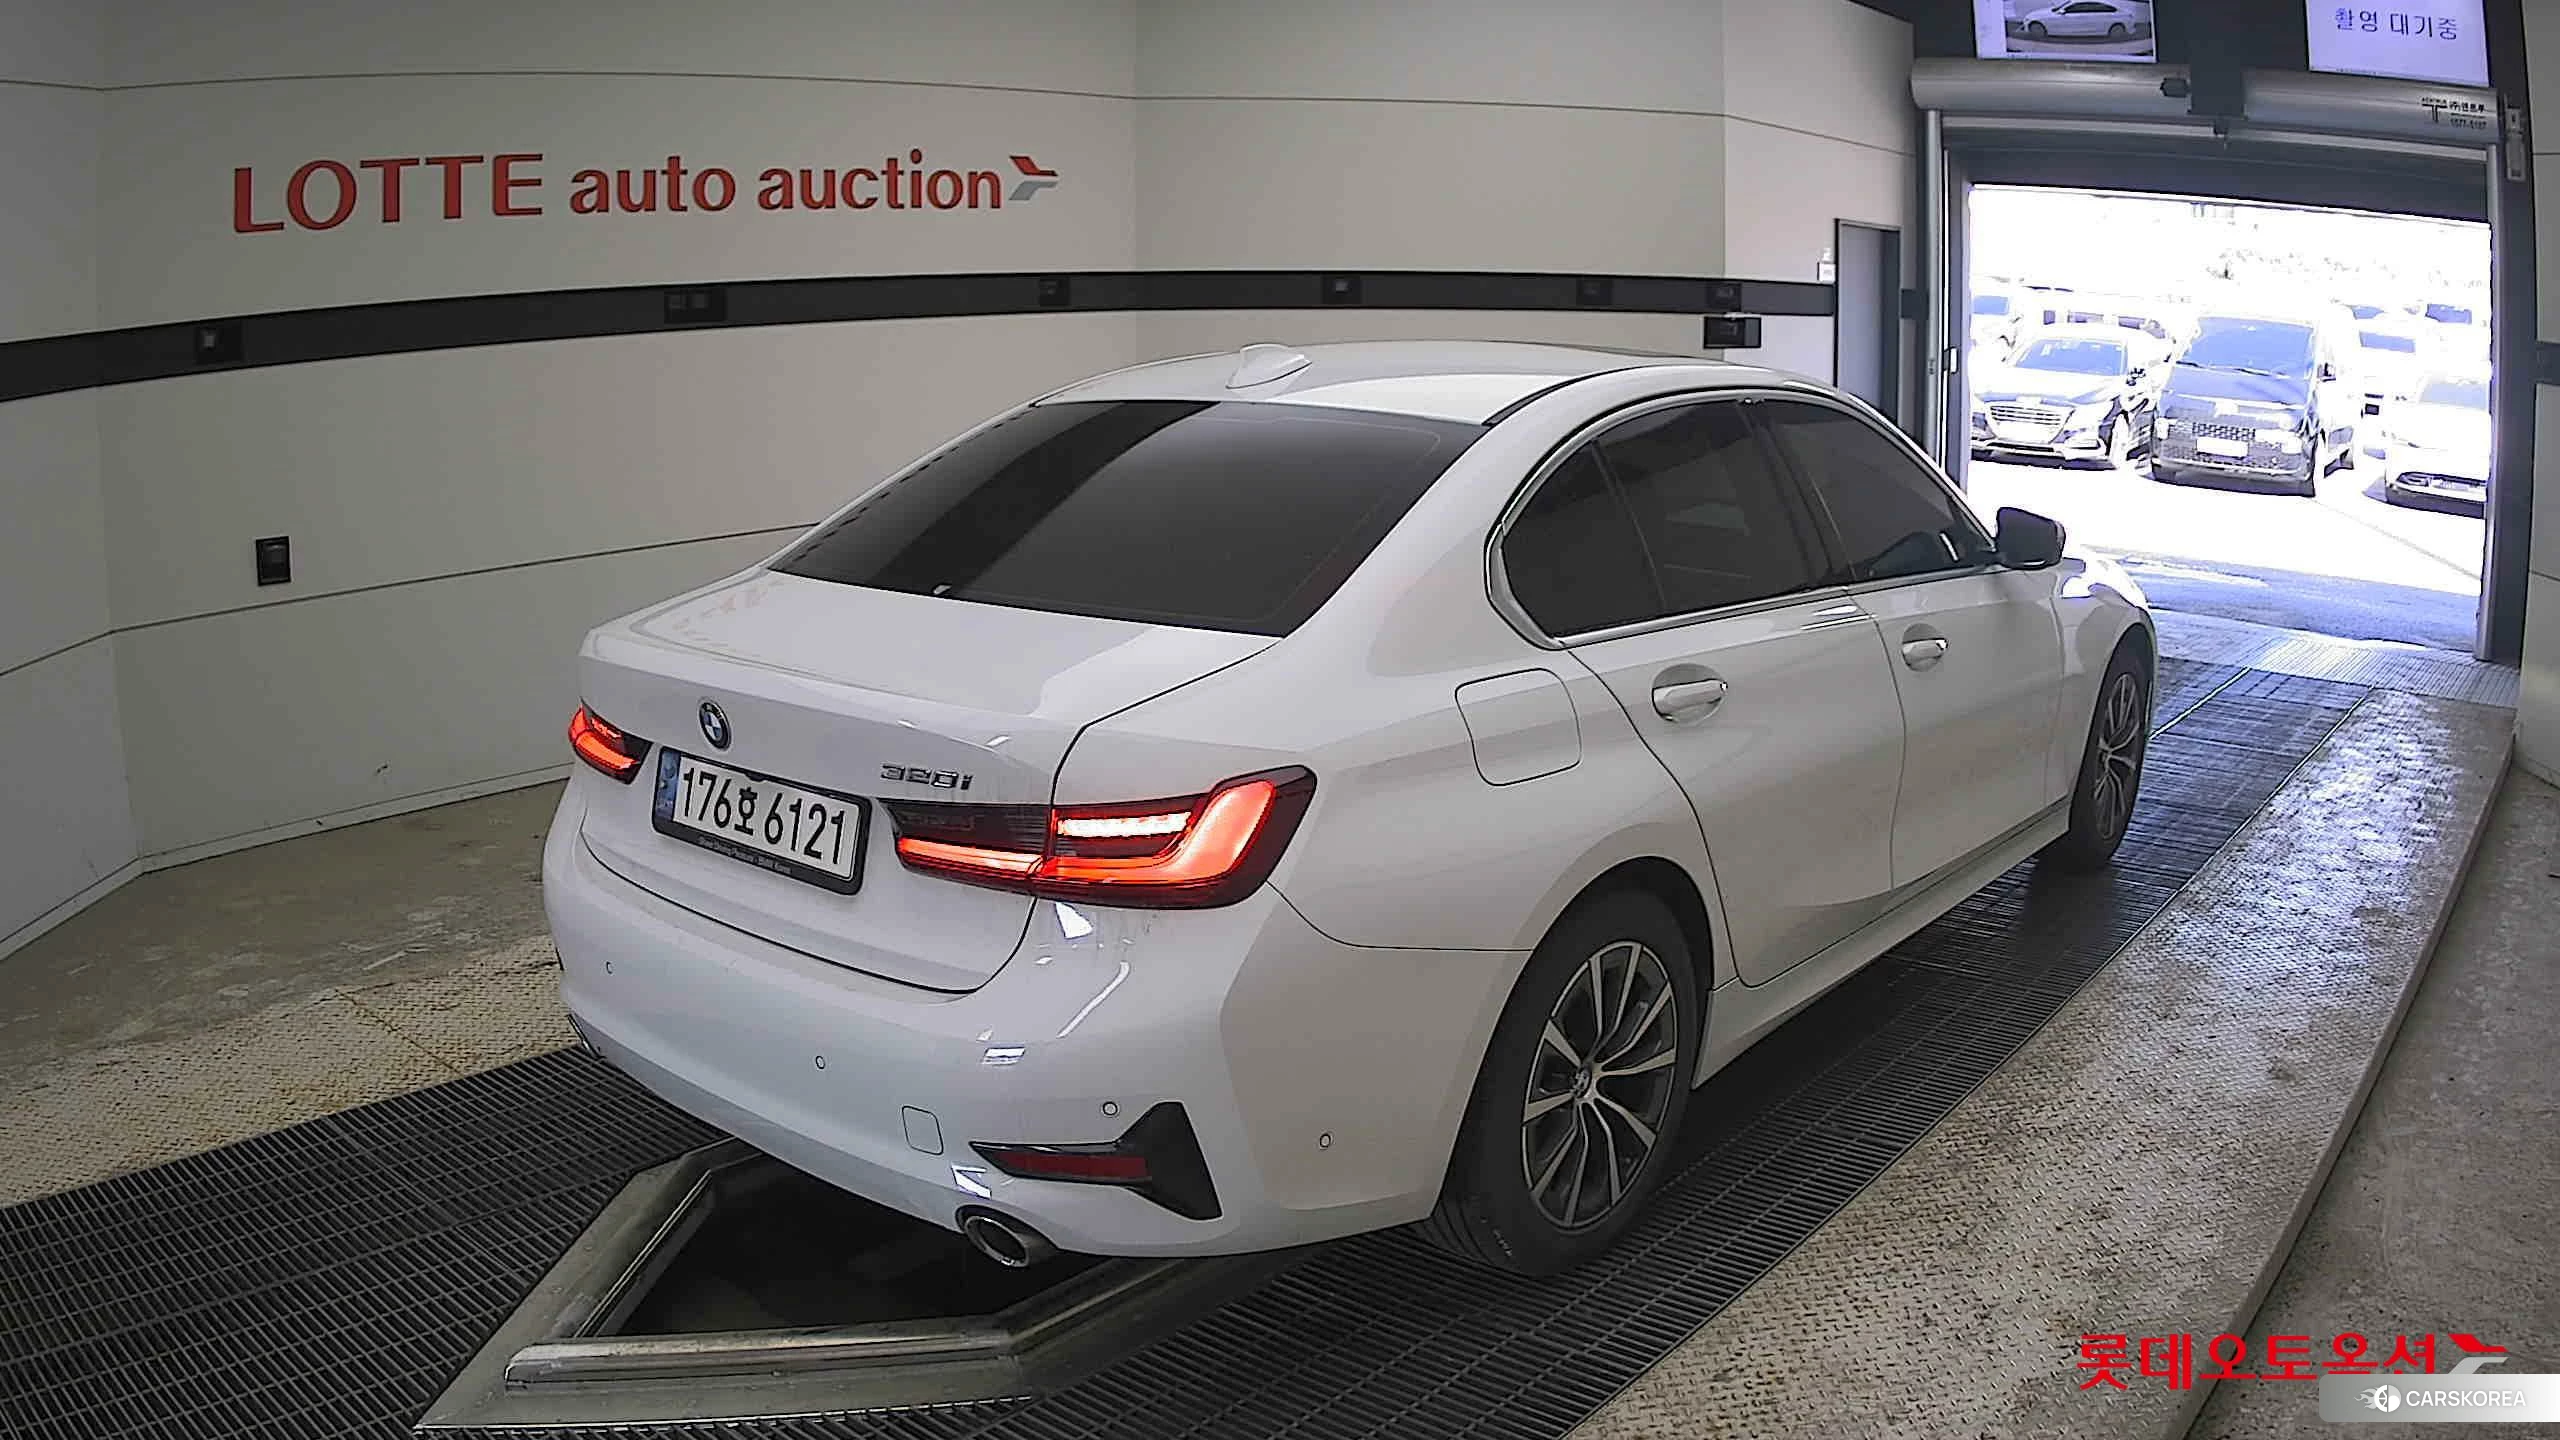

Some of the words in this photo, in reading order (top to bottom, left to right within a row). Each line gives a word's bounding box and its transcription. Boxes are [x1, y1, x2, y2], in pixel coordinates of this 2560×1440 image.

[2335, 7, 2379, 33] 촬영
[2389, 13, 2458, 41] 대기중
[233, 153, 543, 234] LOTTE
[568, 155, 737, 215] auto
[757, 148, 1002, 212] auction
[683, 767, 758, 836] 176호
[764, 792, 846, 866] 6121
